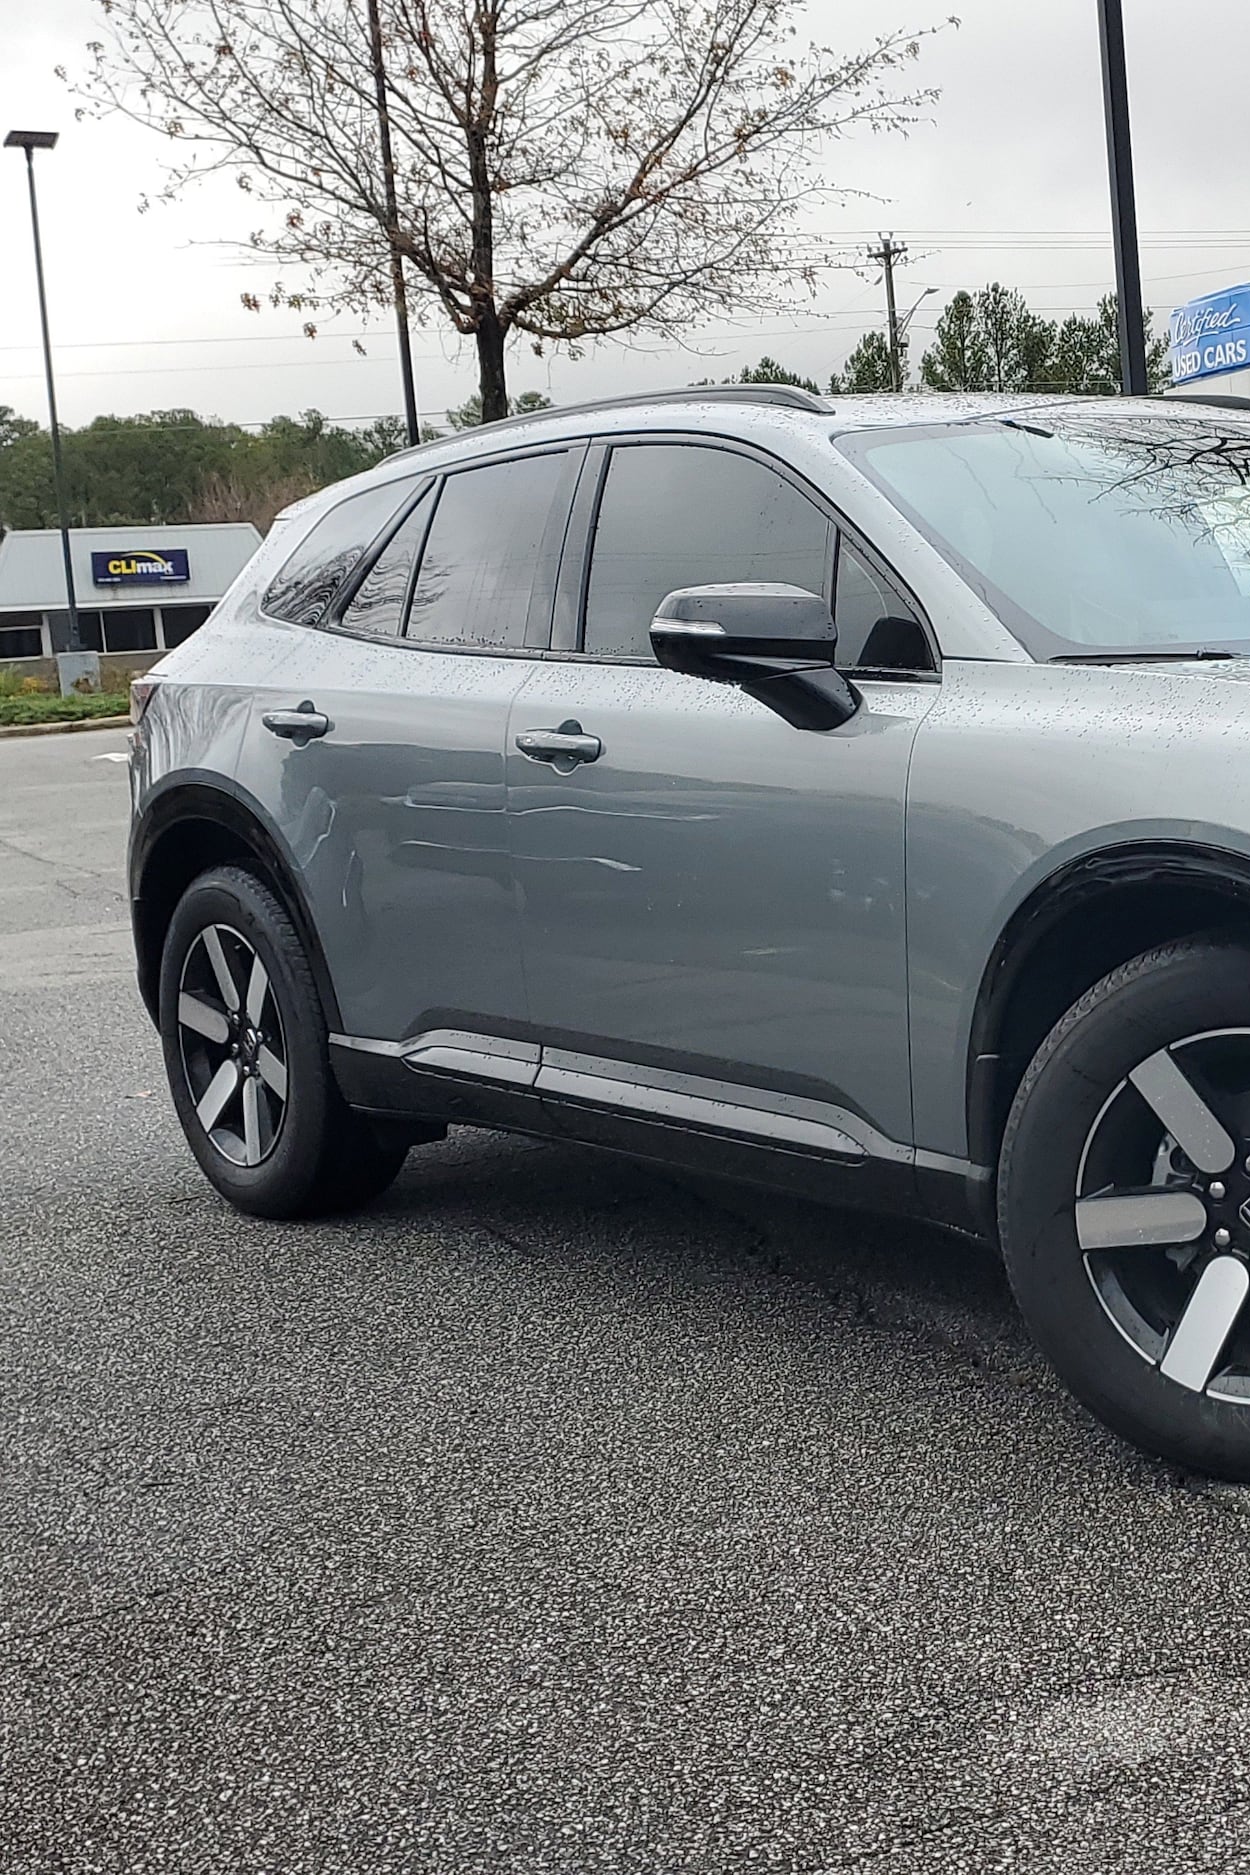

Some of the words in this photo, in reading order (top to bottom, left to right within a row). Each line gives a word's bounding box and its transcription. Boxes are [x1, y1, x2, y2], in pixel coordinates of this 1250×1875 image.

[1174, 303, 1241, 347] Certified
[1174, 351, 1202, 378] USED
[1203, 339, 1248, 369] CARS
[107, 559, 175, 575] CLImax
